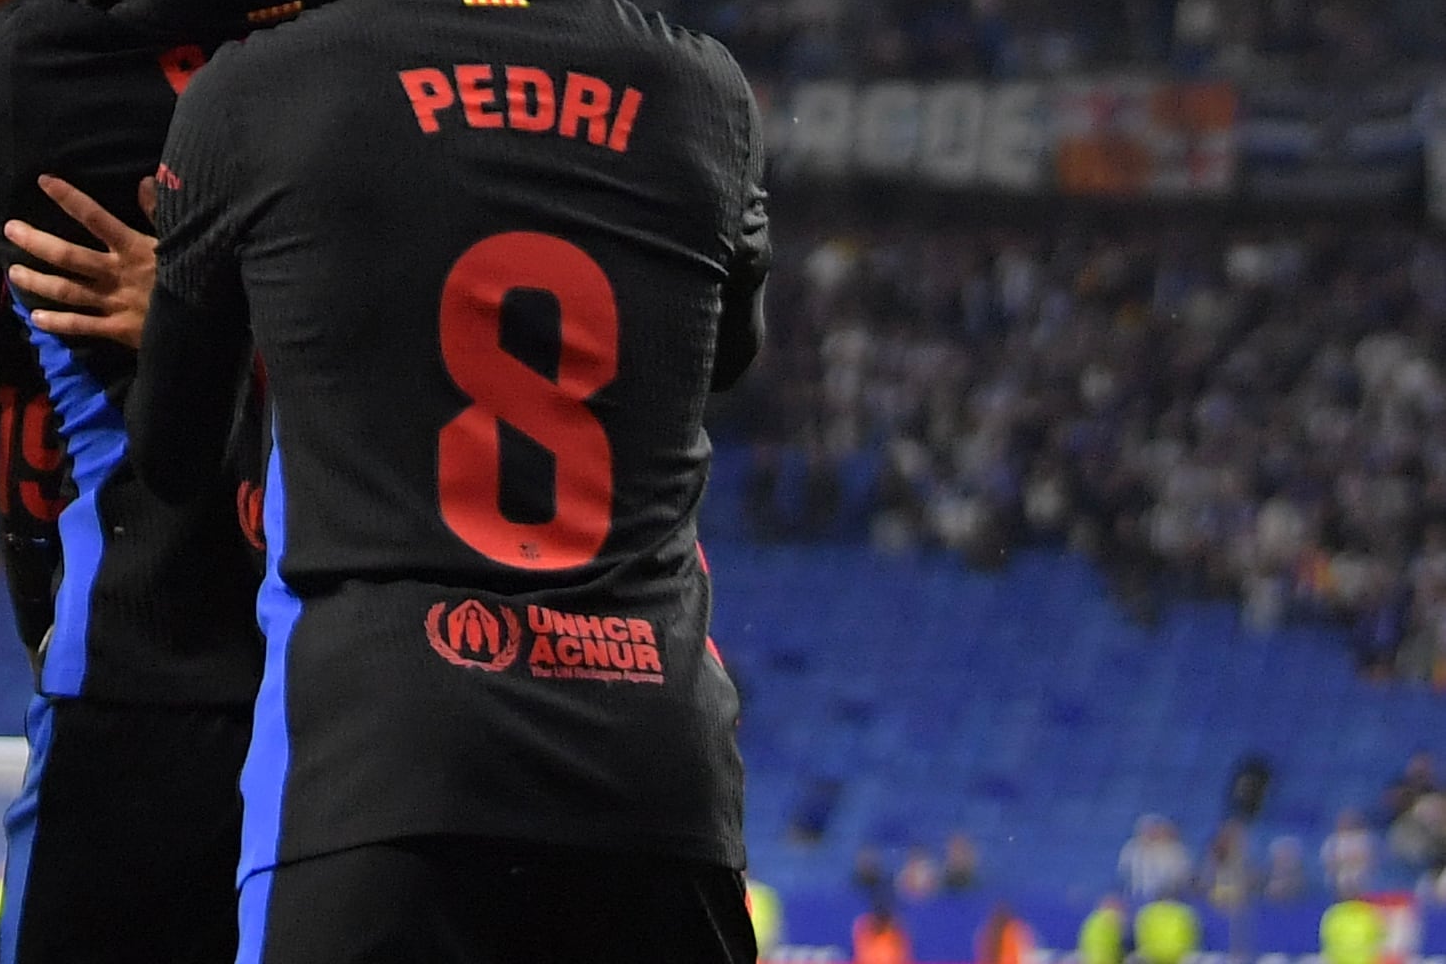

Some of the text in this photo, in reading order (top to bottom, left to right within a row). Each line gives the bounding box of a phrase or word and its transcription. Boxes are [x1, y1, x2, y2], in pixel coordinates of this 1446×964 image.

[398, 64, 644, 154] PEDRI
[437, 230, 619, 570] 8
[527, 604, 656, 645] UNHCR
[529, 634, 663, 674] ACNUR
